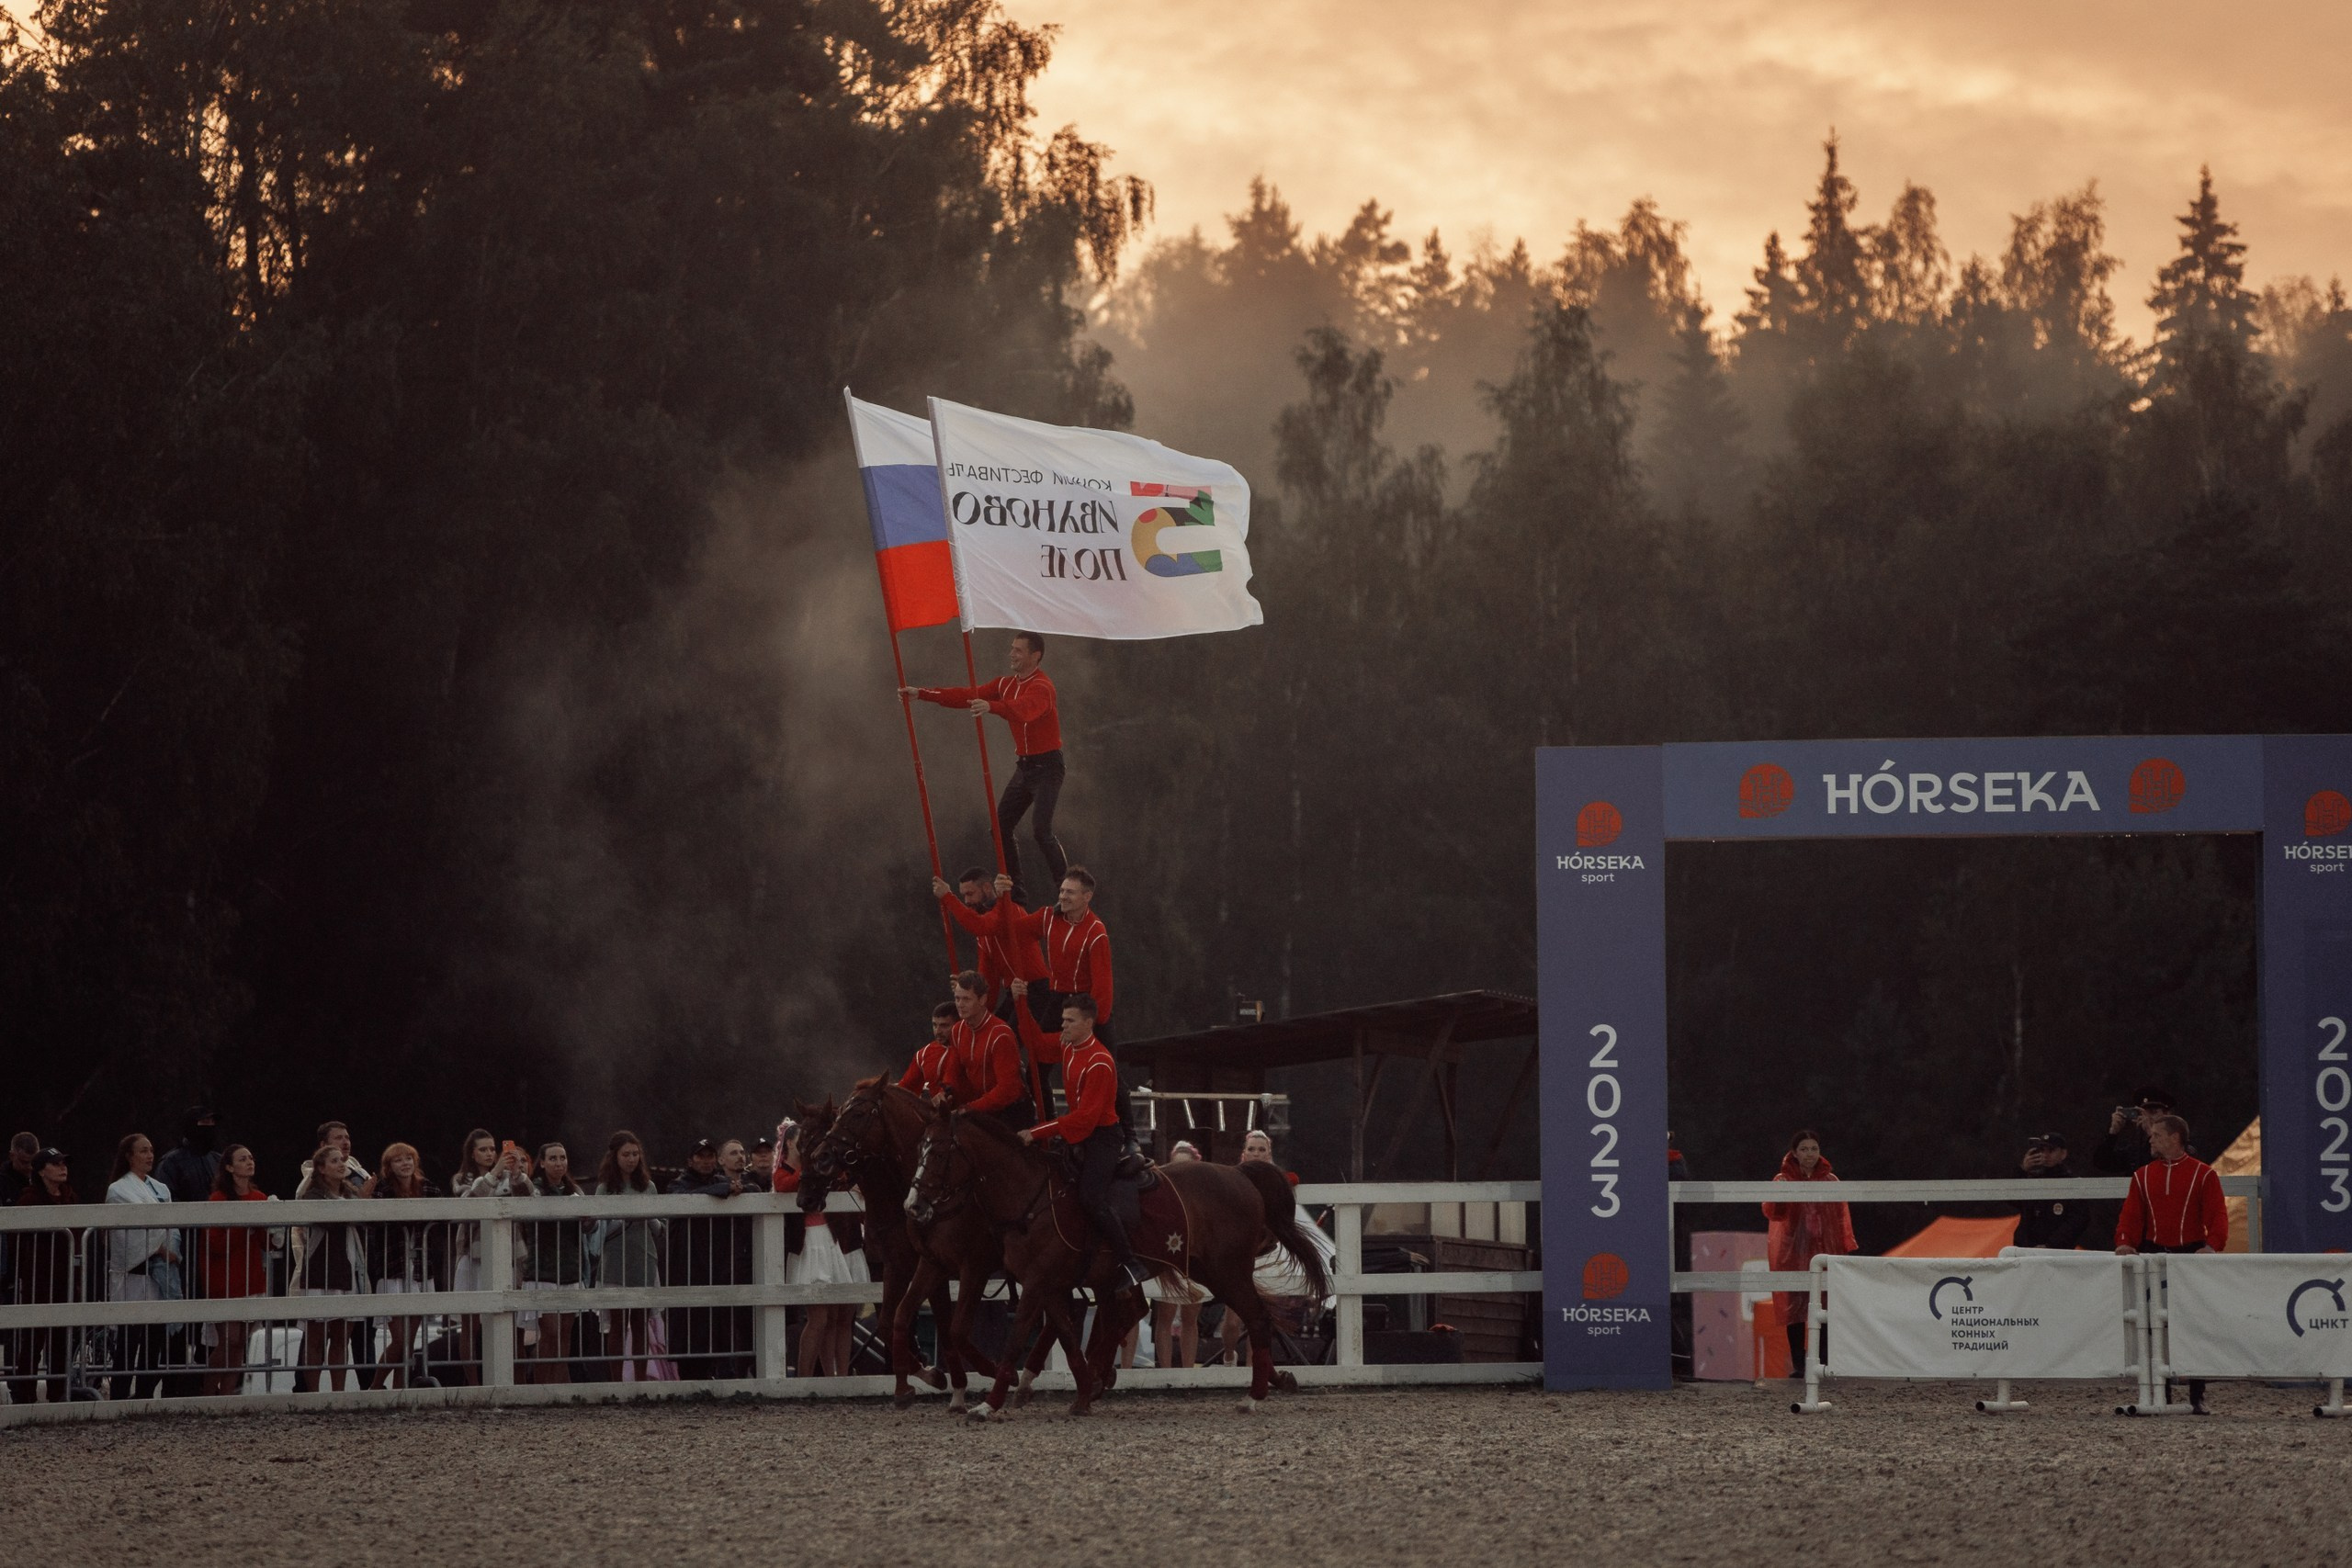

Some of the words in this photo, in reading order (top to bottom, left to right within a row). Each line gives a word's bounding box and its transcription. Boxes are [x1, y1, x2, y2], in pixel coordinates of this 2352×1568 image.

[1822, 758, 2101, 815] HÓRSEKA
[1555, 851, 1645, 870] HÓRSEKA
[2310, 862, 2345, 874] sport
[1580, 873, 1615, 885] sport
[2315, 1015, 2352, 1213] 2023
[1586, 1022, 1623, 1219] 2023
[1562, 1303, 1652, 1323] HÓRSEKA
[1951, 1306, 1984, 1315] ЦЕНТР
[1951, 1317, 2040, 1327] НАЦИОНАЛЬНЫХ
[2309, 1318, 2350, 1330] ЦНКТ
[1587, 1325, 1622, 1337] sport
[1951, 1329, 1996, 1338] КОННЫХ
[1951, 1340, 2009, 1351] ТРАДИЦИЙ
